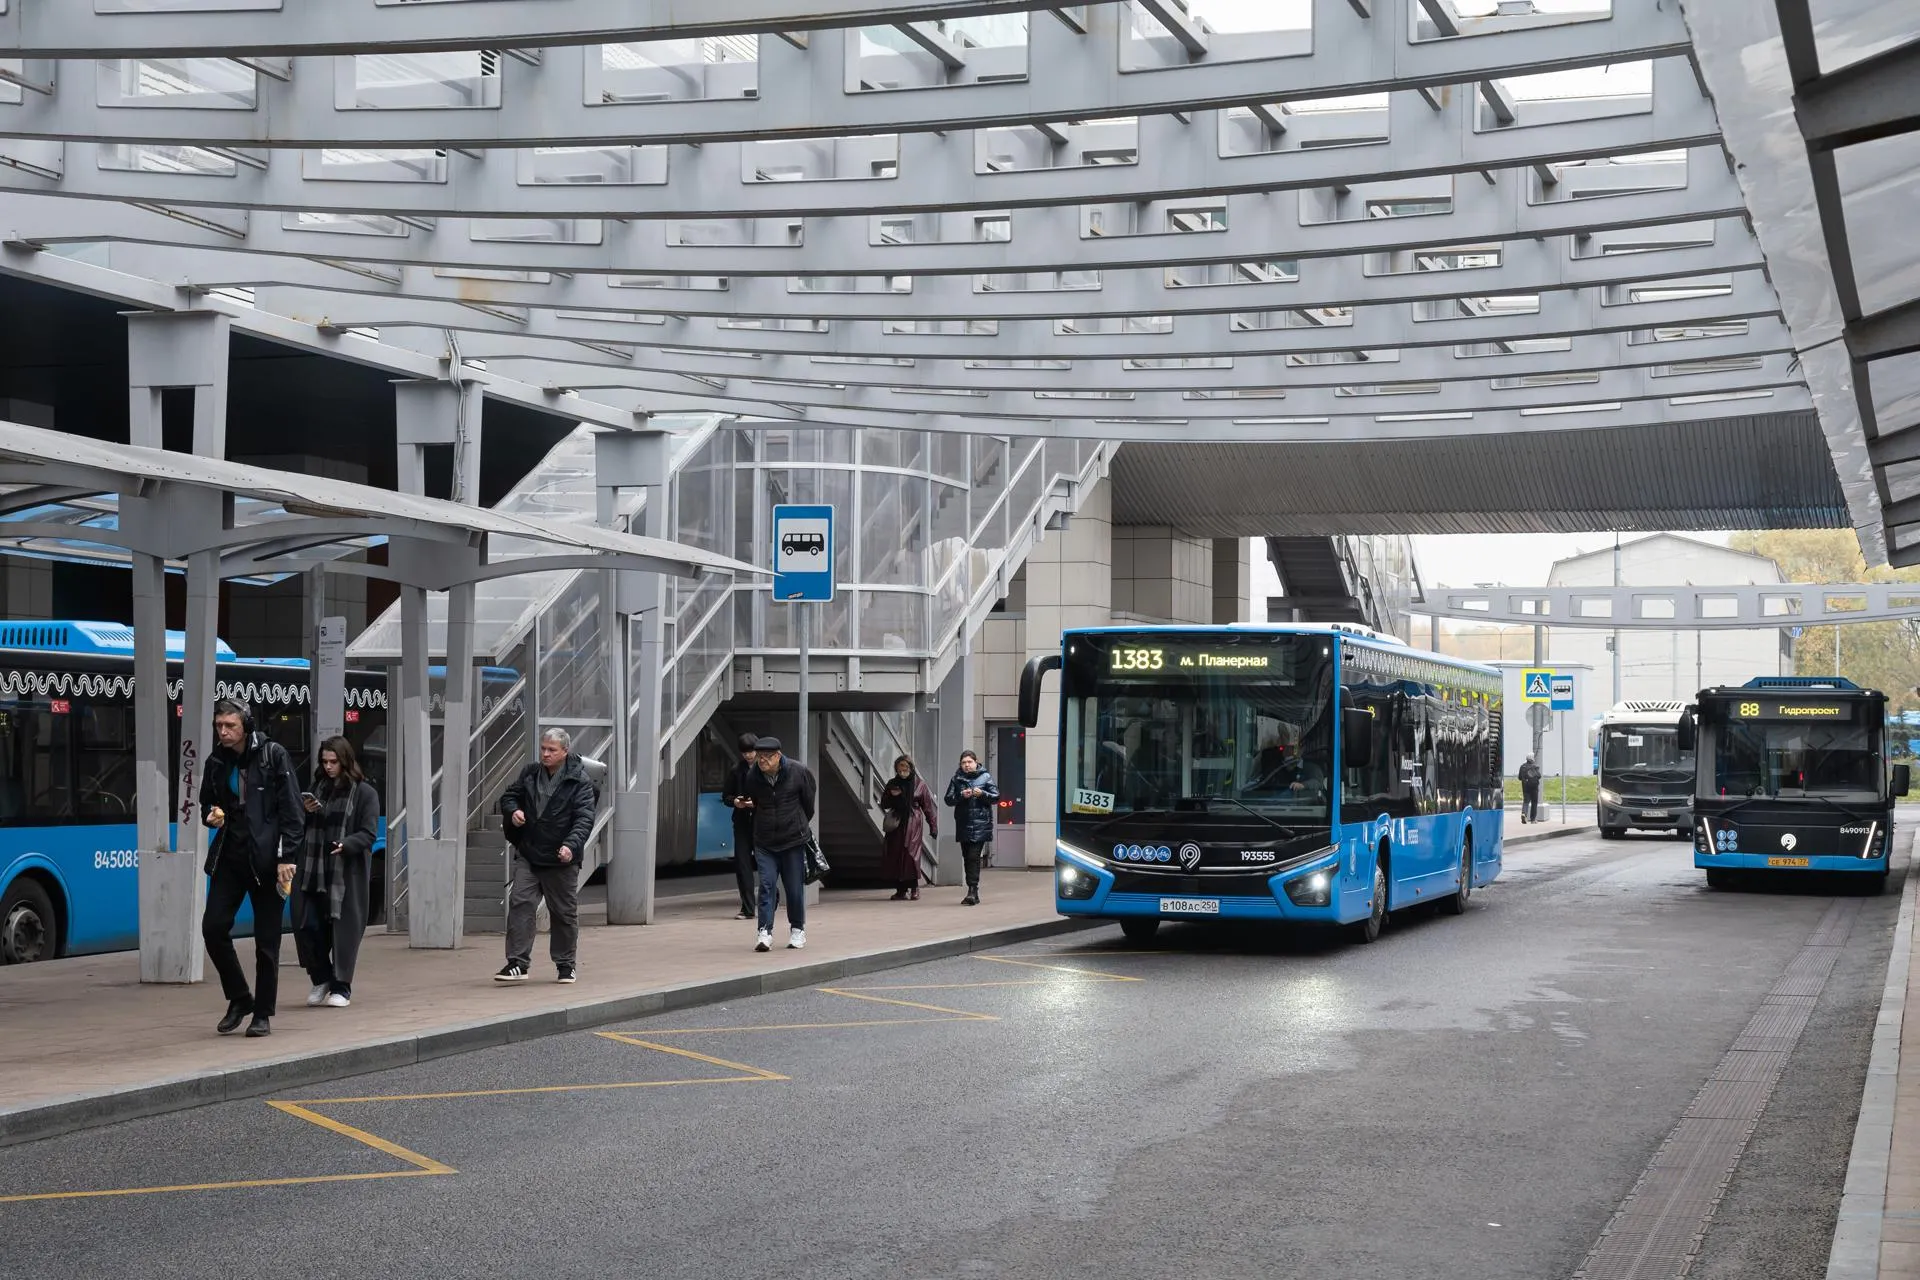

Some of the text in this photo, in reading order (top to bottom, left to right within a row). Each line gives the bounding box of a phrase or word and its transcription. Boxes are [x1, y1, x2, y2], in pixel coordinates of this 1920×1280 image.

[1112, 649, 1268, 669] 1383 м. Планерная
[1740, 703, 1840, 716] 88 Гидропроект
[1079, 791, 1110, 808] 1383
[1240, 851, 1275, 861] 193555
